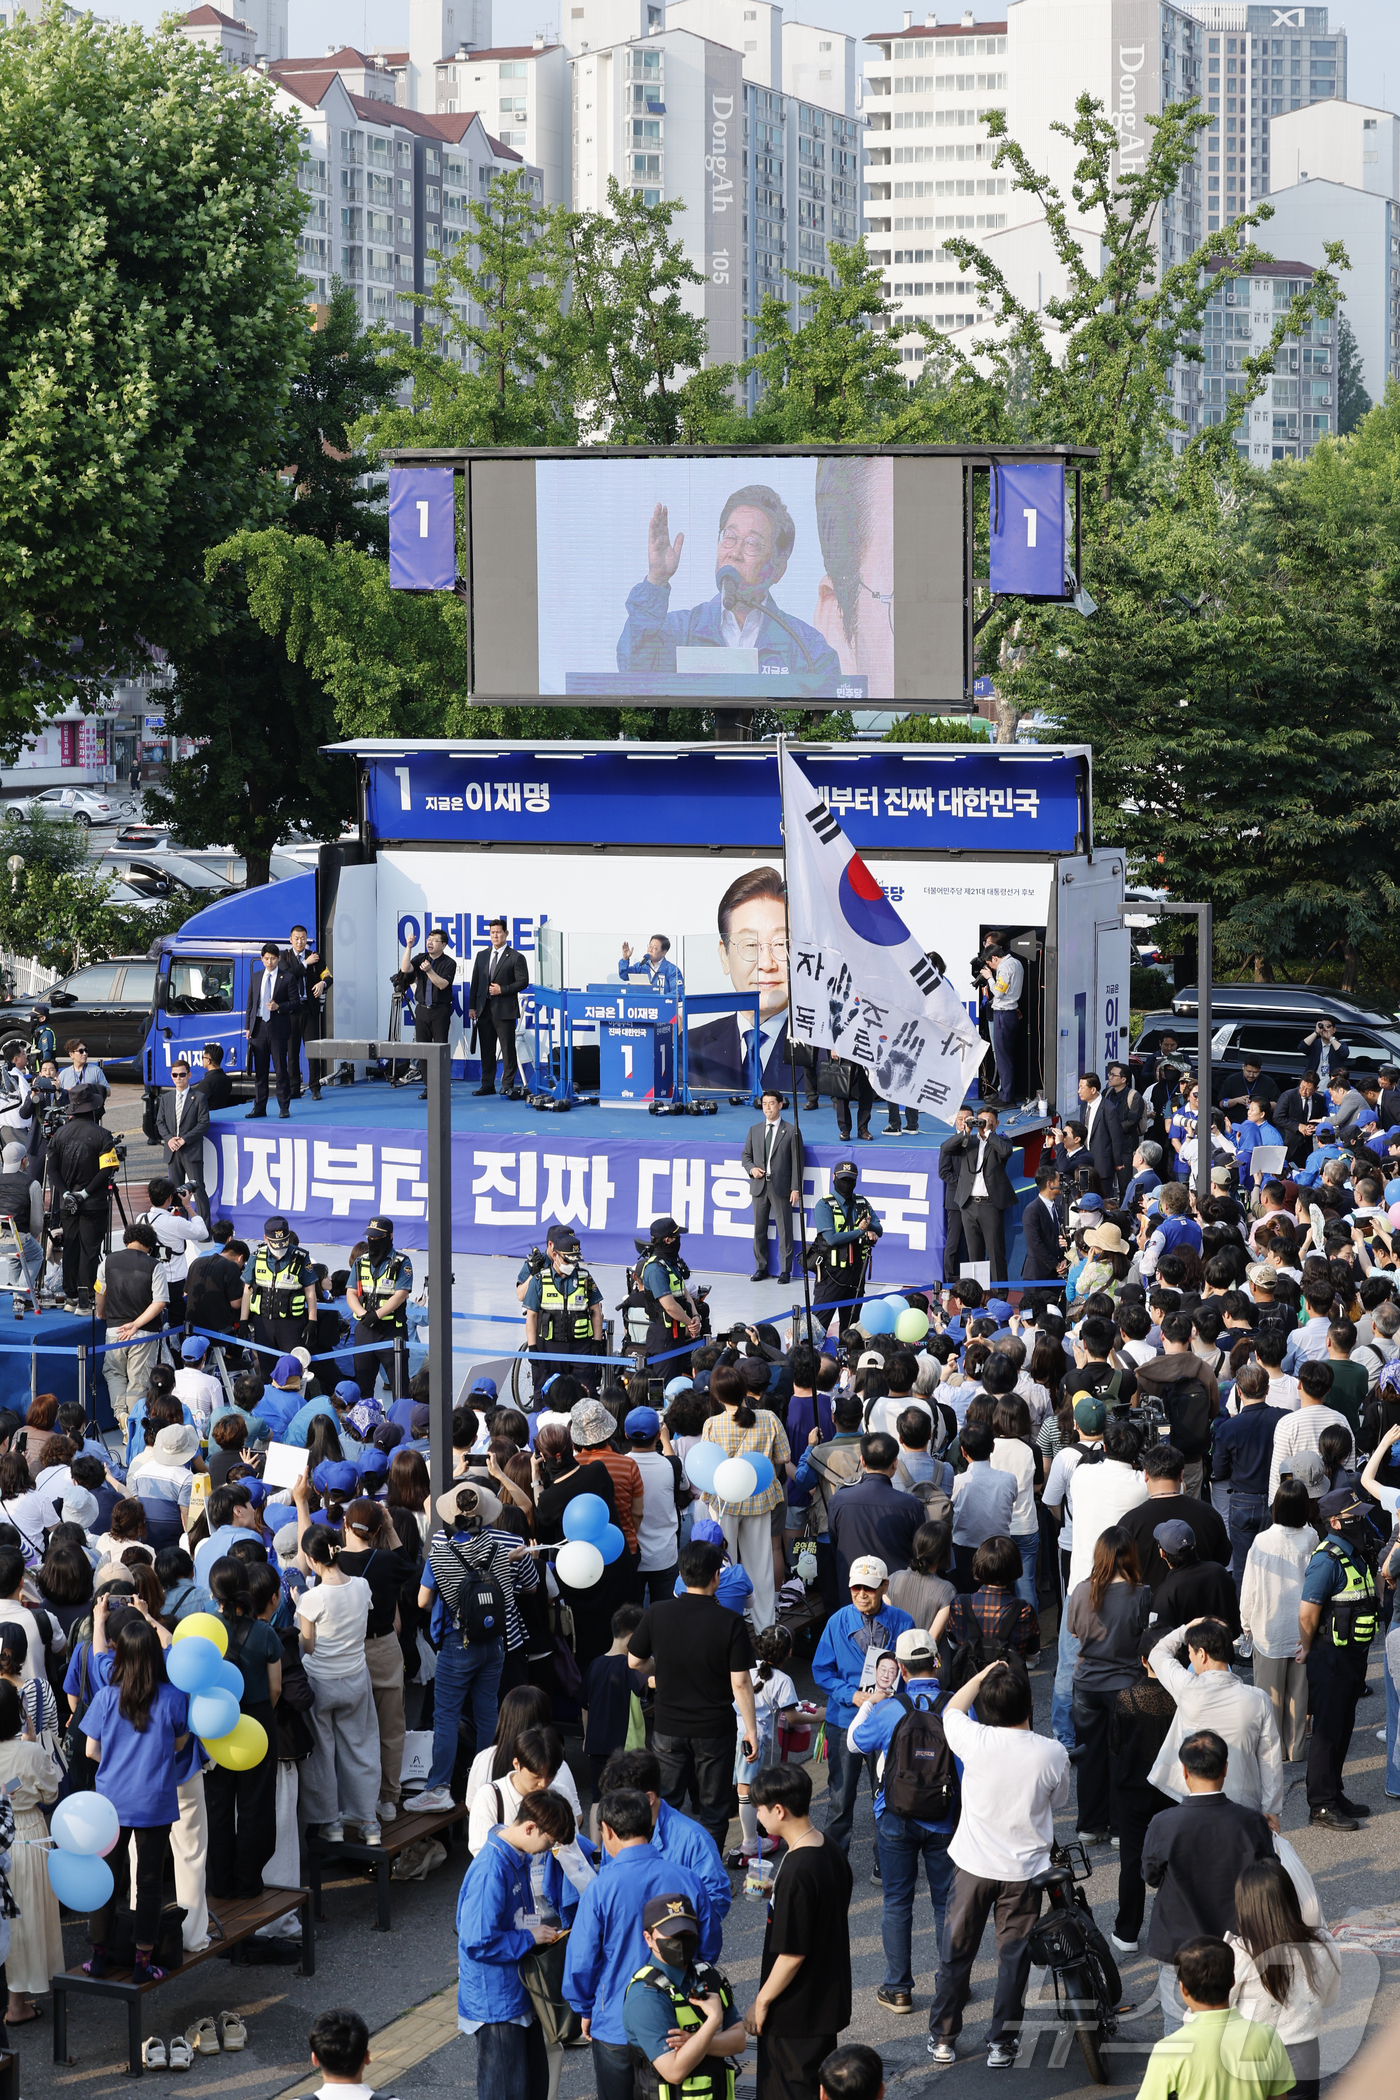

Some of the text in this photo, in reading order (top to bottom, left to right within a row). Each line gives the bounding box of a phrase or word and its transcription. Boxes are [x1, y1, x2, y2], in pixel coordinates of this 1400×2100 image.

[1111, 44, 1145, 174] DongAh
[705, 94, 734, 214] DongAh
[712, 248, 730, 285] 105
[416, 500, 429, 537] 1
[1023, 508, 1037, 547] 1
[836, 687, 863, 699] 민주당
[395, 767, 550, 813] 1 지금은 이재명
[883, 787, 935, 817] 진짜
[939, 787, 1040, 819] 대한민국
[923, 887, 1035, 897] 더불어민주당 제21대 대통령선거 후보
[1105, 983, 1120, 995] 지금은
[585, 998, 659, 1020] 지금은 1 이재명
[622, 1028, 647, 1038] 대한민국
[1074, 991, 1087, 1106] 1
[1104, 997, 1119, 1068] 이재
[162, 1042, 205, 1067] 1 이재
[621, 1045, 633, 1078] 1
[202, 1134, 930, 1251] 이제부터 진짜 대한국
